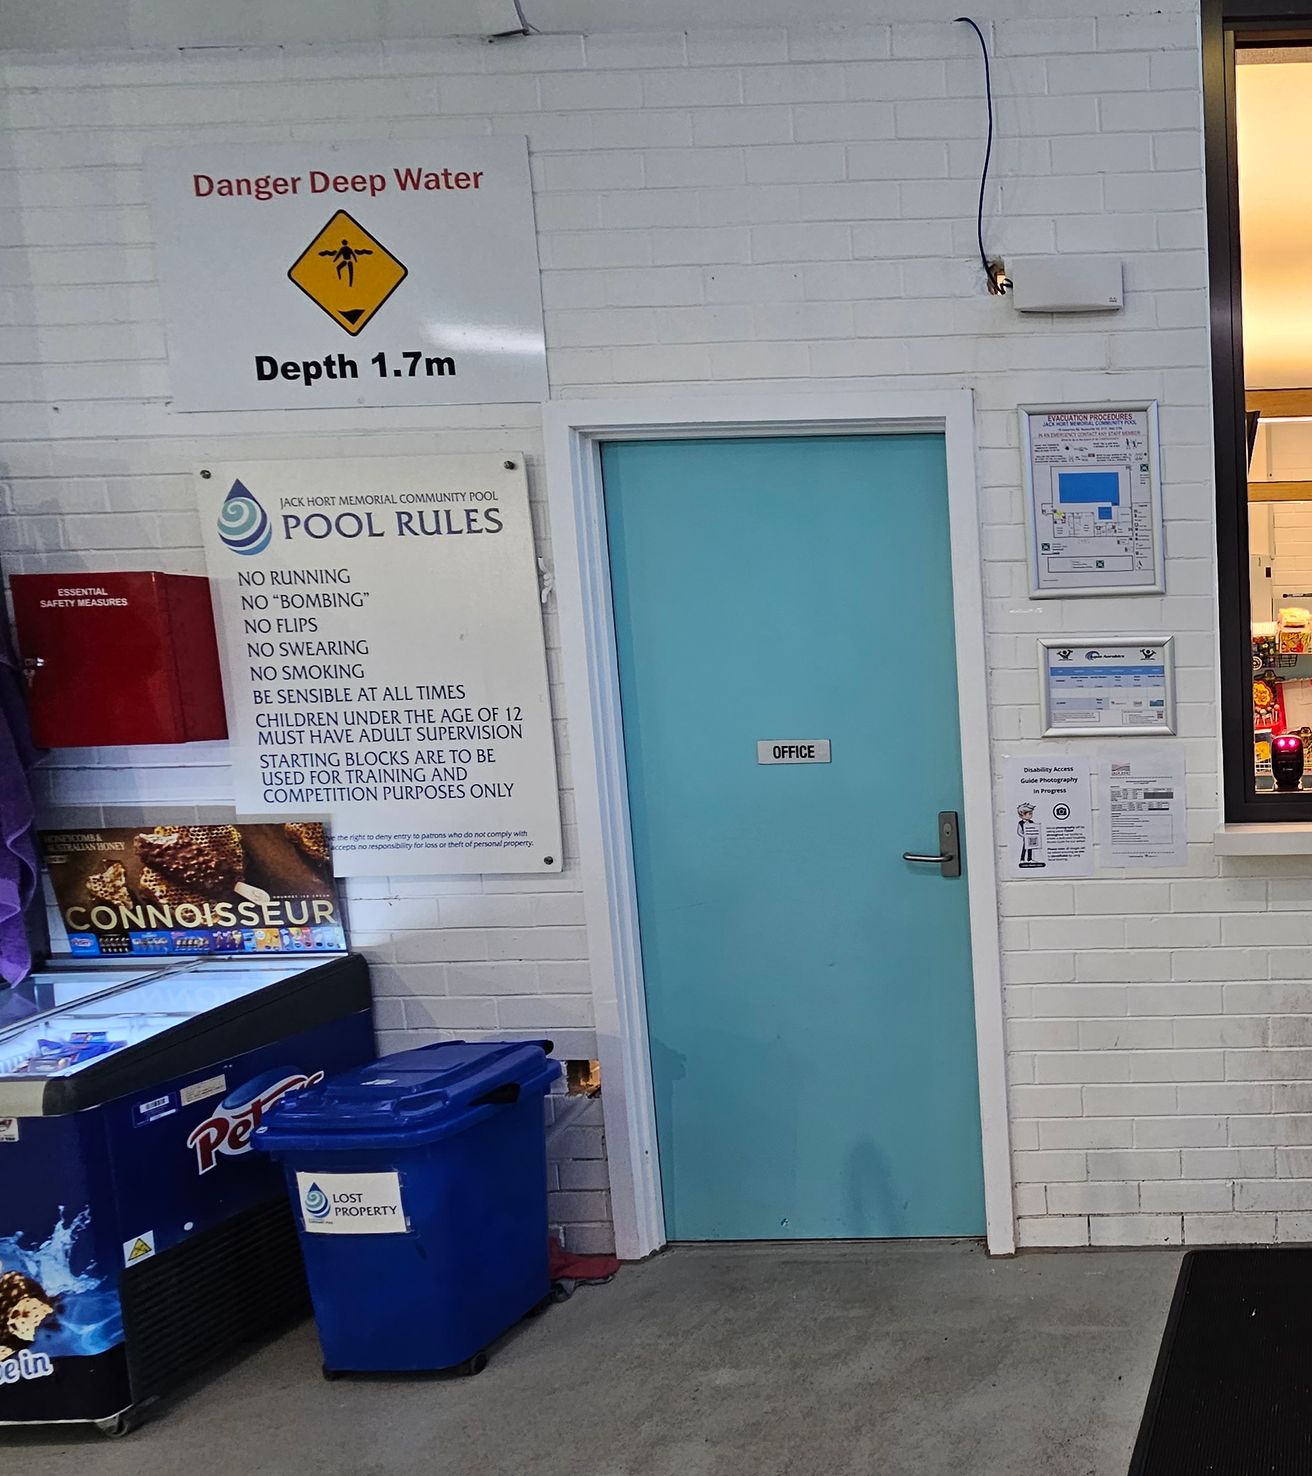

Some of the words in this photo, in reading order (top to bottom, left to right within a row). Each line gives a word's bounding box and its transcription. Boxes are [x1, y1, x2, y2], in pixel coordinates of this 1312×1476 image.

[193, 174, 301, 200] Danger
[309, 171, 386, 196] Deep
[394, 167, 483, 191] Water
[255, 353, 358, 386] Depth
[371, 352, 456, 378] 1.7m
[280, 497, 305, 509] JACK
[307, 496, 336, 507] HORT
[339, 494, 397, 506] MEMORIAL
[399, 492, 466, 504] COMMUNITY
[469, 491, 498, 502] POOL
[282, 511, 385, 540] POOL
[395, 507, 504, 537] RULES
[238, 571, 265, 586] NO
[270, 568, 350, 585] RUNNING
[57, 588, 108, 596] ESSENTIAL
[40, 600, 75, 608] SAFETY
[77, 598, 128, 607] MEASURES
[241, 595, 269, 610] NO
[244, 619, 271, 634] NO
[277, 618, 317, 633] FLIPS
[248, 643, 274, 658] NO
[280, 640, 369, 657] SWEARING
[250, 665, 277, 681] NO
[282, 663, 364, 680] SMOKING
[253, 690, 272, 704] BE
[277, 687, 352, 704] SENSIBLE
[358, 687, 376, 702] AT
[383, 686, 412, 701] ALL
[416, 684, 465, 700] TIMES
[256, 712, 339, 728] CHILDREN
[344, 710, 401, 726] UNDER
[405, 709, 435, 724] THE
[441, 708, 473, 723] AGE
[478, 707, 498, 722] OF
[506, 706, 523, 721] 12
[258, 730, 305, 746] MUST
[310, 729, 354, 744] HAVE
[359, 727, 412, 743] ADULT
[416, 724, 523, 741] SUPERVISION
[260, 753, 340, 769] STARTING
[346, 751, 409, 767] BLOCKS
[414, 750, 445, 765] ARE
[449, 749, 471, 764] TO
[477, 748, 496, 763] BE
[773, 745, 815, 759] OFFICE
[262, 771, 305, 786] USED
[311, 769, 341, 785] FOR
[346, 768, 426, 783] TRAINING
[431, 766, 468, 782] AND
[263, 786, 378, 803] COMPETITION
[383, 784, 465, 801] PURPOSES
[470, 783, 514, 798] ONLY
[96, 842, 125, 851] HONEY
[350, 834, 365, 842] right
[368, 842, 413, 850] responsibility
[473, 840, 502, 848] personal
[503, 840, 534, 848] property.
[65, 900, 337, 930] CONNOISSEUR
[333, 1193, 363, 1203] LOST
[335, 1205, 397, 1216] PROPERTY
